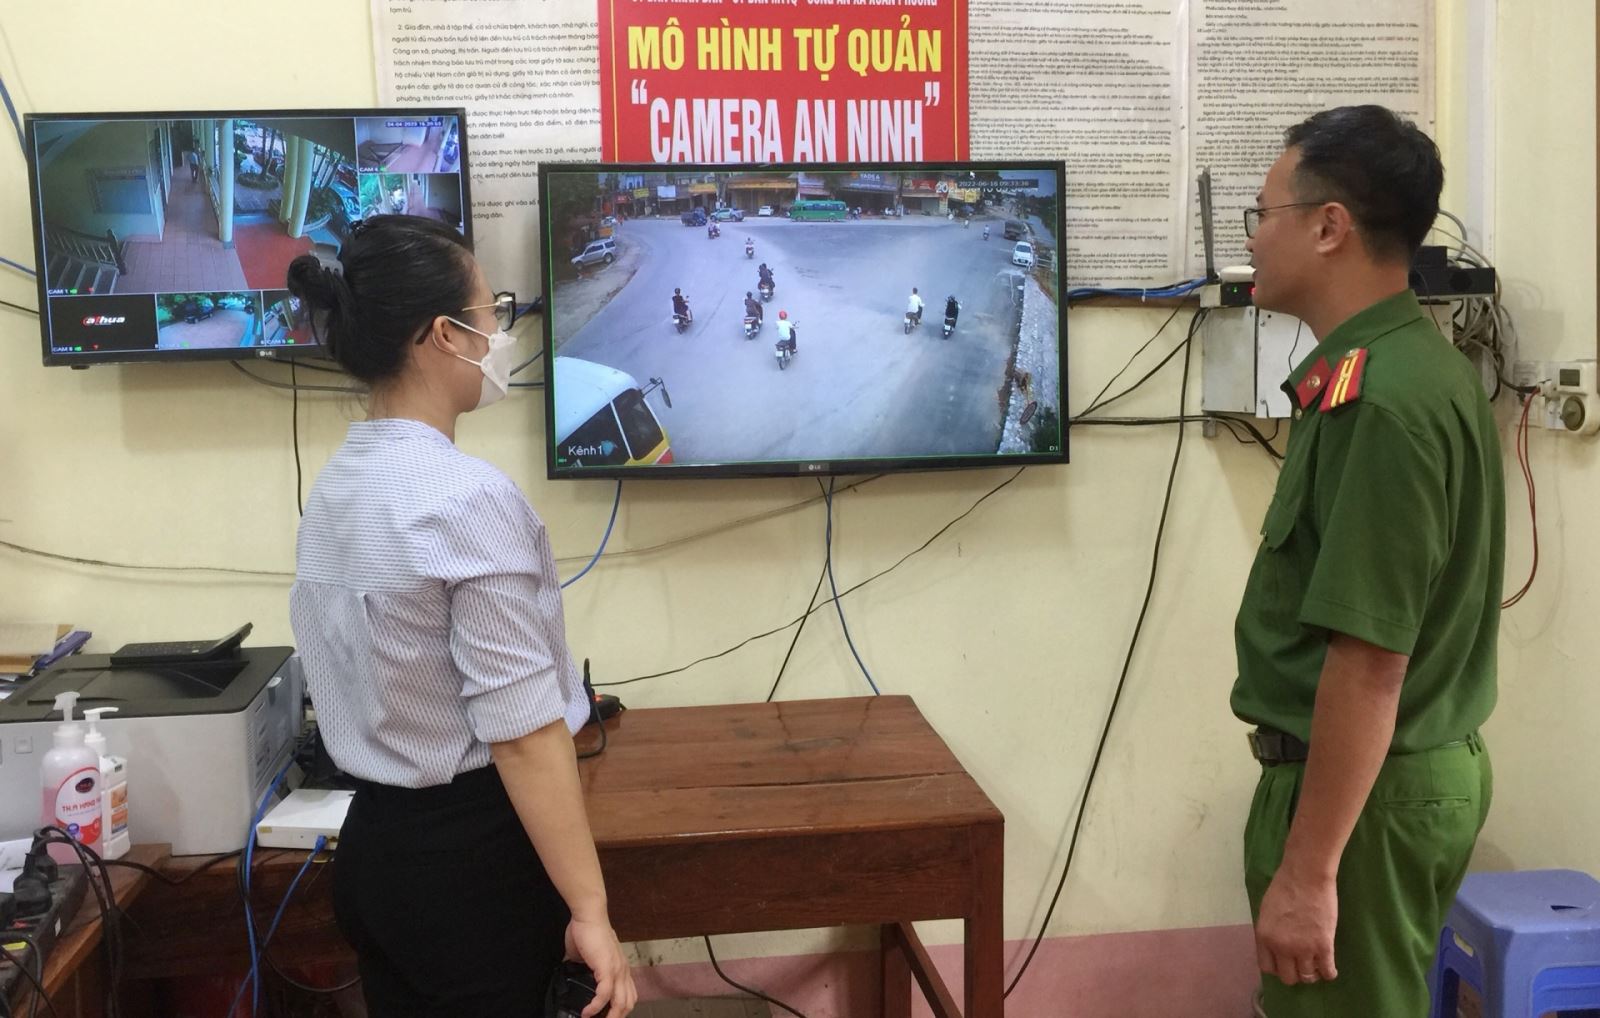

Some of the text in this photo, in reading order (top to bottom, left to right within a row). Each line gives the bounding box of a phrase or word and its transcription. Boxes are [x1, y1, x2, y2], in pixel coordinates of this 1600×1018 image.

[628, 17, 685, 70] MÔ
[697, 18, 782, 71] HÌNH
[793, 24, 840, 81] TỰ
[847, 14, 942, 77] QUẢN
[793, 98, 836, 162] AN
